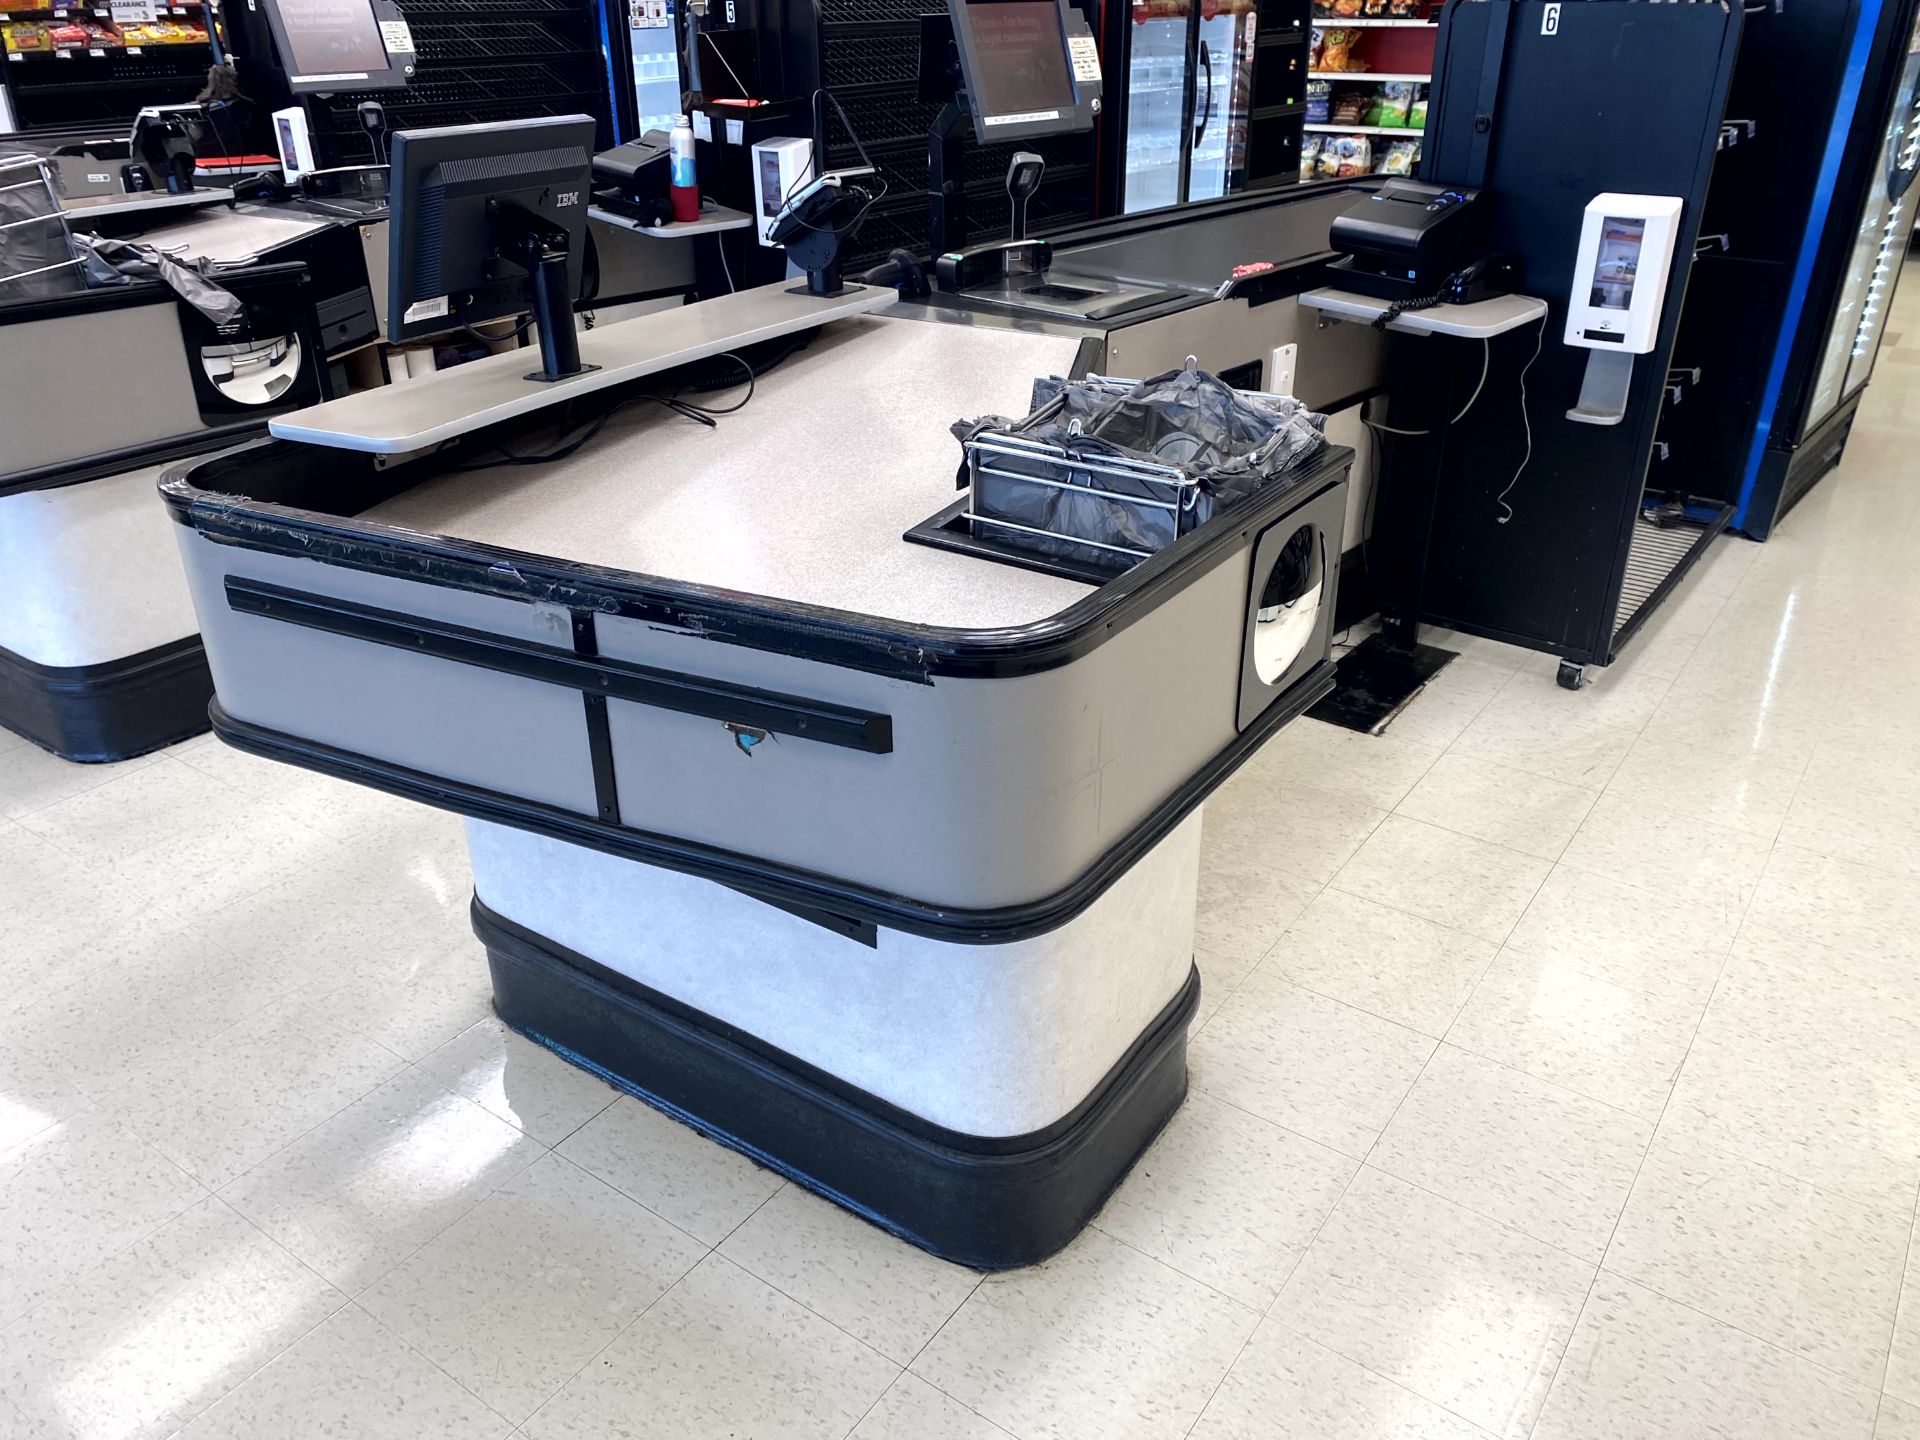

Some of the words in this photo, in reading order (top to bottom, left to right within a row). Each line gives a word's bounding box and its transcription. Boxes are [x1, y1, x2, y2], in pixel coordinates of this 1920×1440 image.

[727, 2, 734, 21] 5
[1546, 7, 1558, 32] 6
[556, 191, 579, 208] IBM
